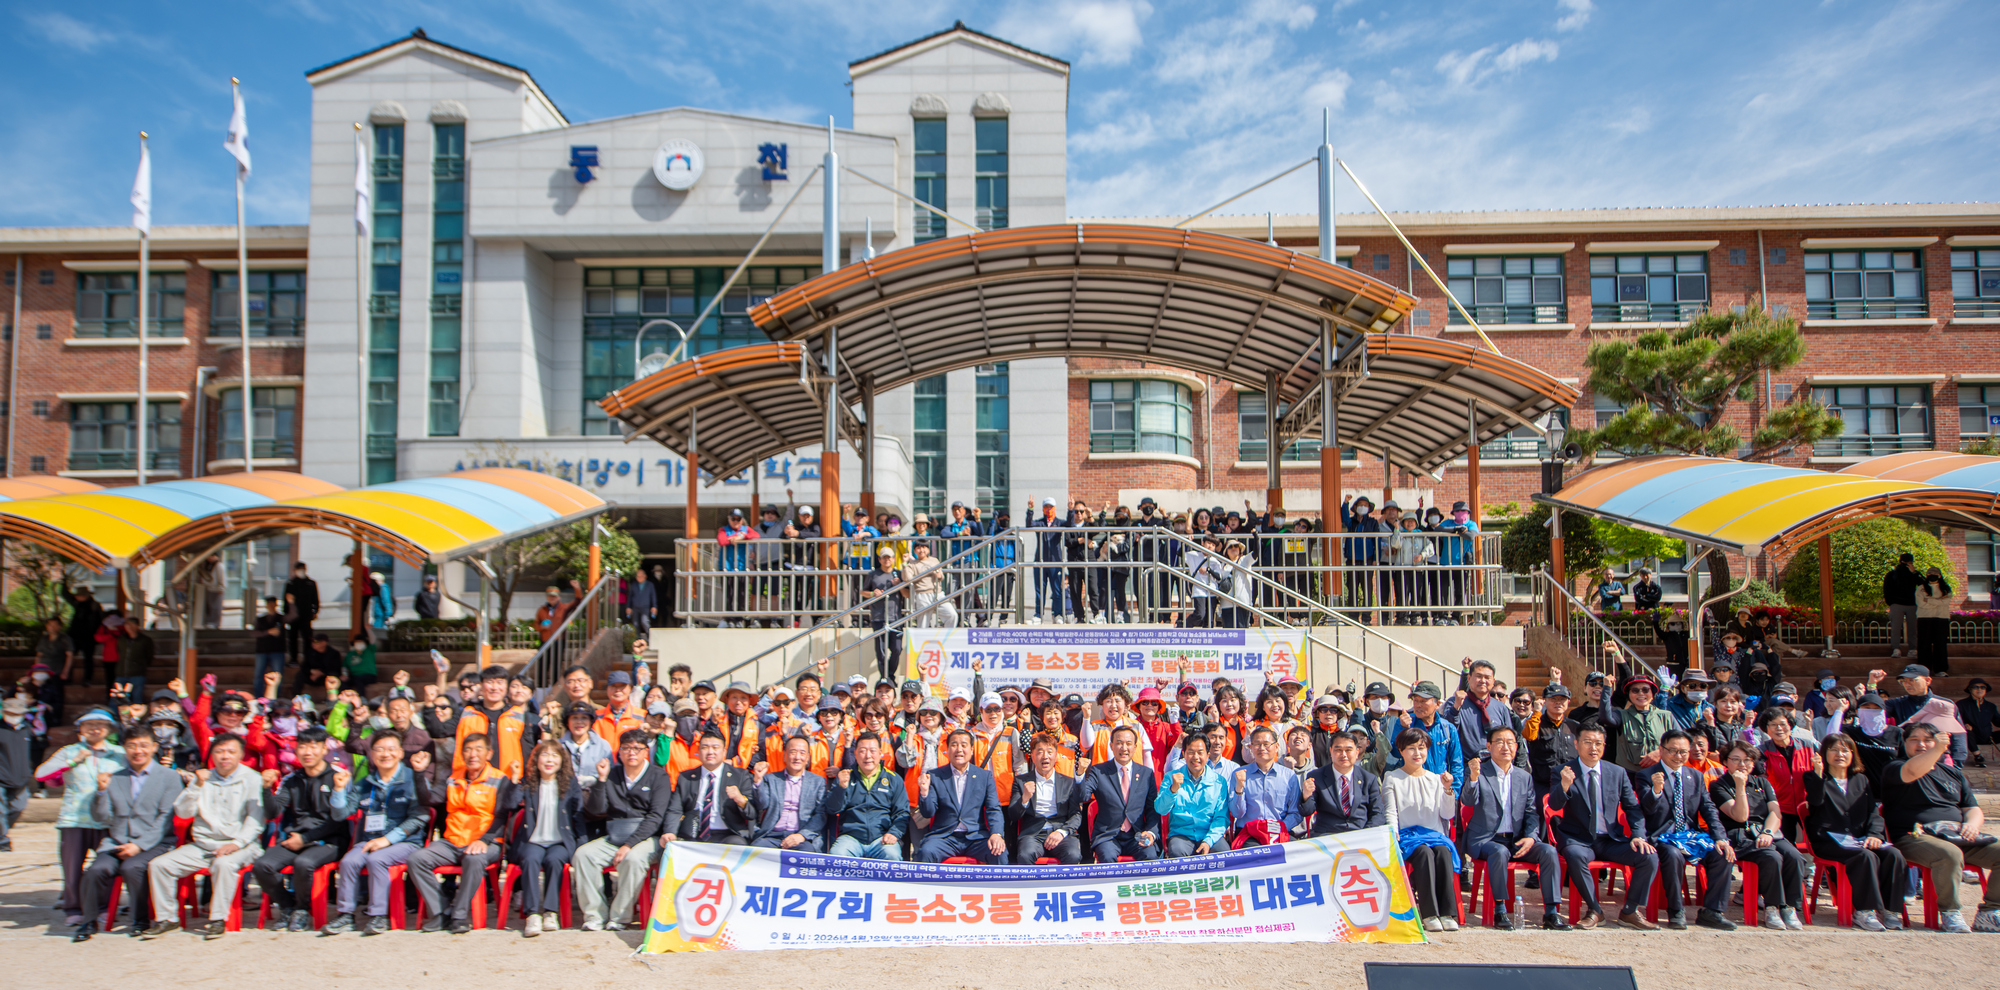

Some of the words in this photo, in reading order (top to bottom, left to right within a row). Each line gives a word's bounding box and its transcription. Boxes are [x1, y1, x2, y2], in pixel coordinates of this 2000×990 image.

[569, 144, 599, 184] 동
[757, 142, 788, 181] 천
[764, 456, 822, 484] 학교
[923, 649, 941, 678] 경
[950, 651, 1019, 670] 제27회
[1025, 651, 1101, 671] 농소3동
[1105, 651, 1145, 671] 체육
[1151, 660, 1220, 673] 명랑동회
[1224, 652, 1262, 671] 대회
[1271, 650, 1292, 677] 축
[799, 857, 826, 866] 기념품
[833, 858, 859, 868] 선착순
[861, 861, 889, 870] 400명
[799, 867, 818, 876] 경품
[824, 867, 842, 877] 삼성
[844, 868, 874, 878] 62인치
[686, 878, 725, 927] 경
[1250, 874, 1323, 911] 대회
[1339, 864, 1380, 913] 축
[740, 885, 873, 923] 제27회
[884, 893, 1023, 924] 농소3동
[1033, 890, 1106, 923] 체육
[1117, 894, 1245, 924] 명랑운동회
[1255, 922, 1296, 933] 점심제공]
